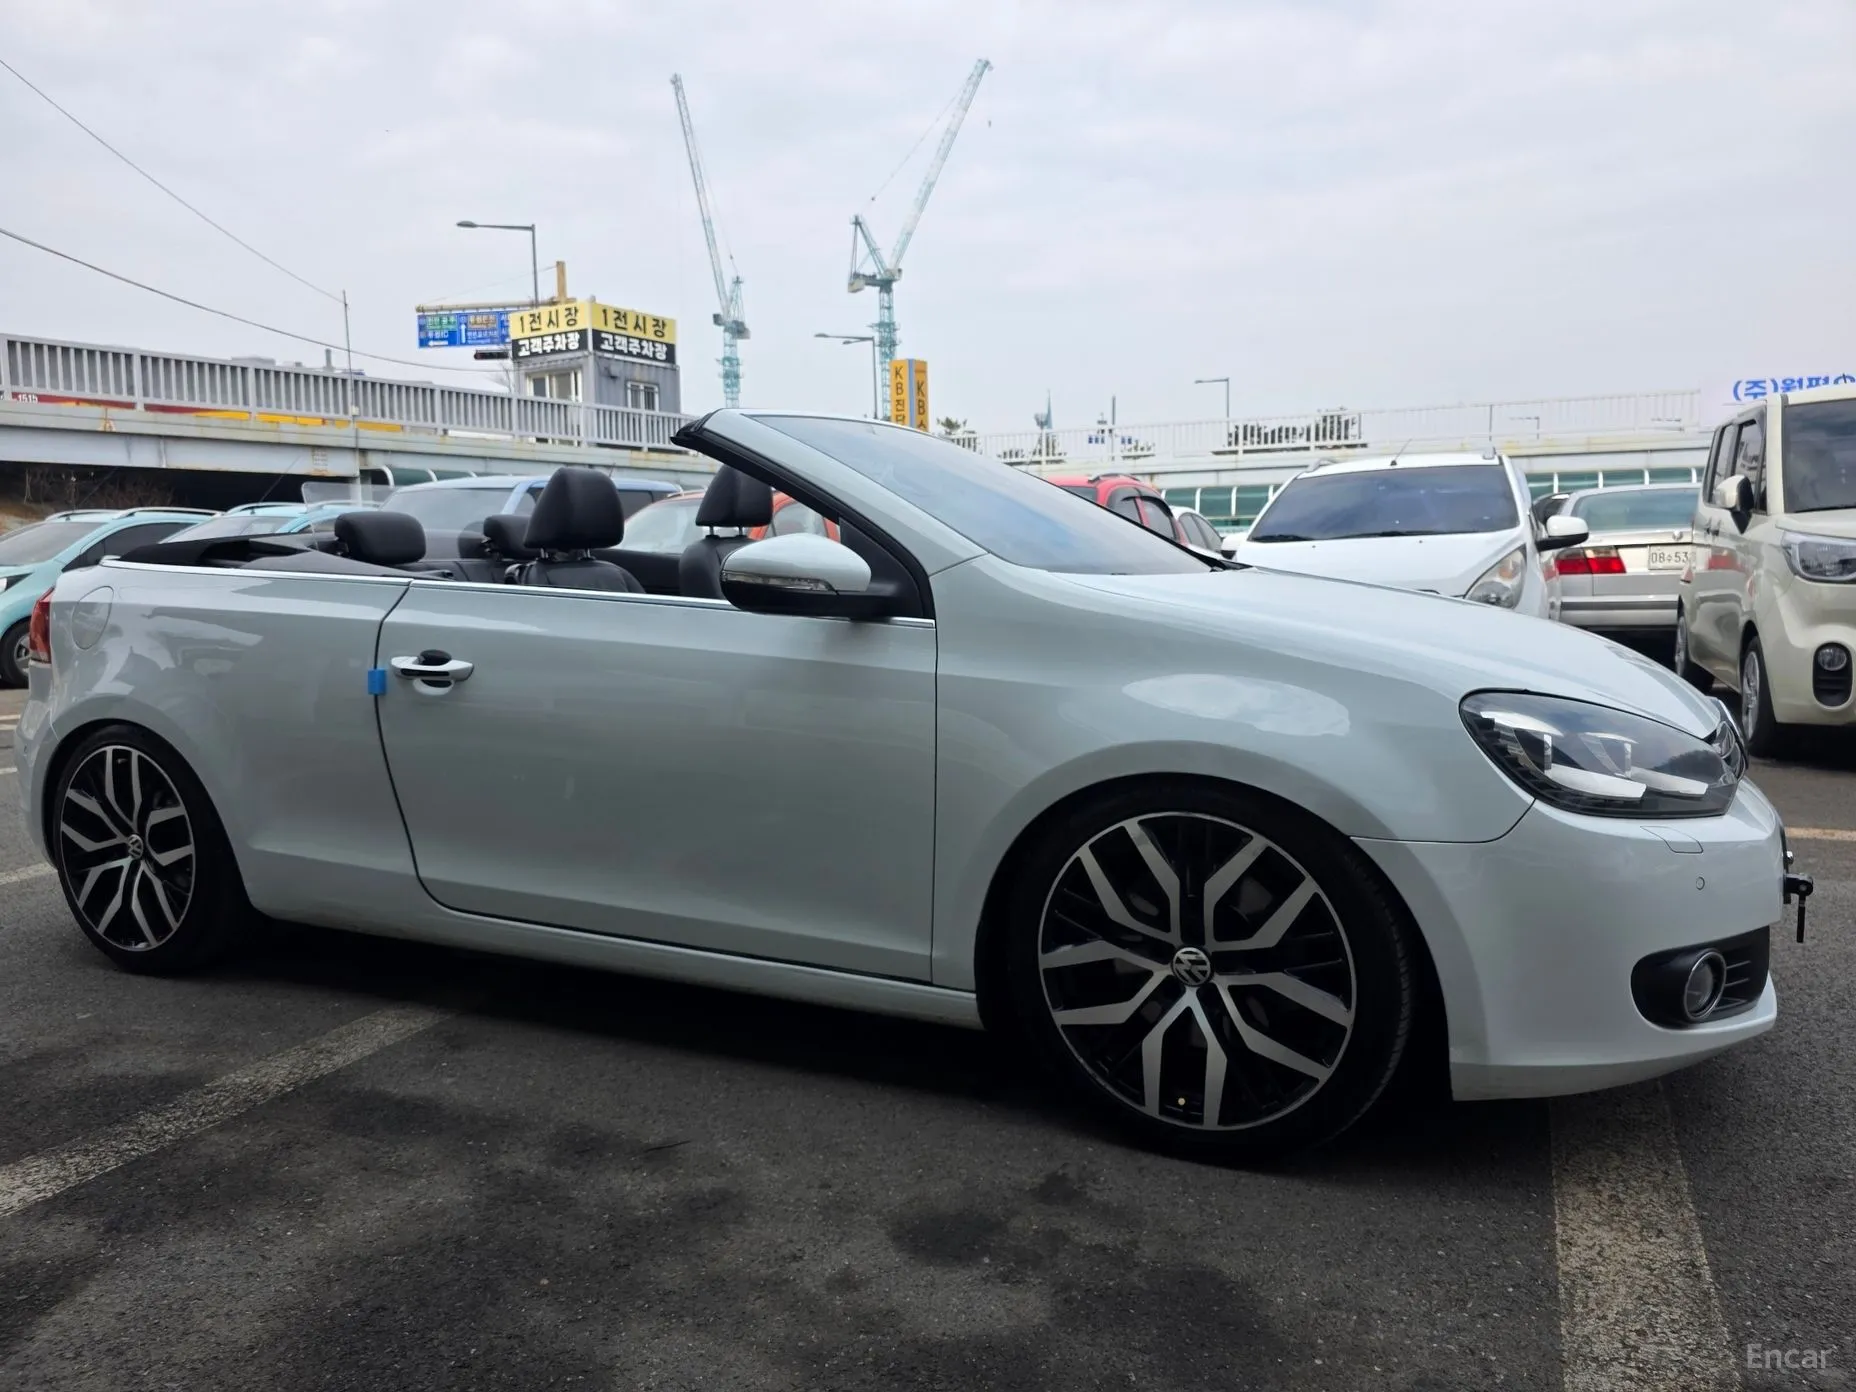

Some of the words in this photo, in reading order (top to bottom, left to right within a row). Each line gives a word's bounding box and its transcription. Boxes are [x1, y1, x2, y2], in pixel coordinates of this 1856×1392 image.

[602, 308, 667, 338] 1전시장
[518, 331, 580, 357] 고객주차장
[600, 332, 668, 360] 고객주차장
